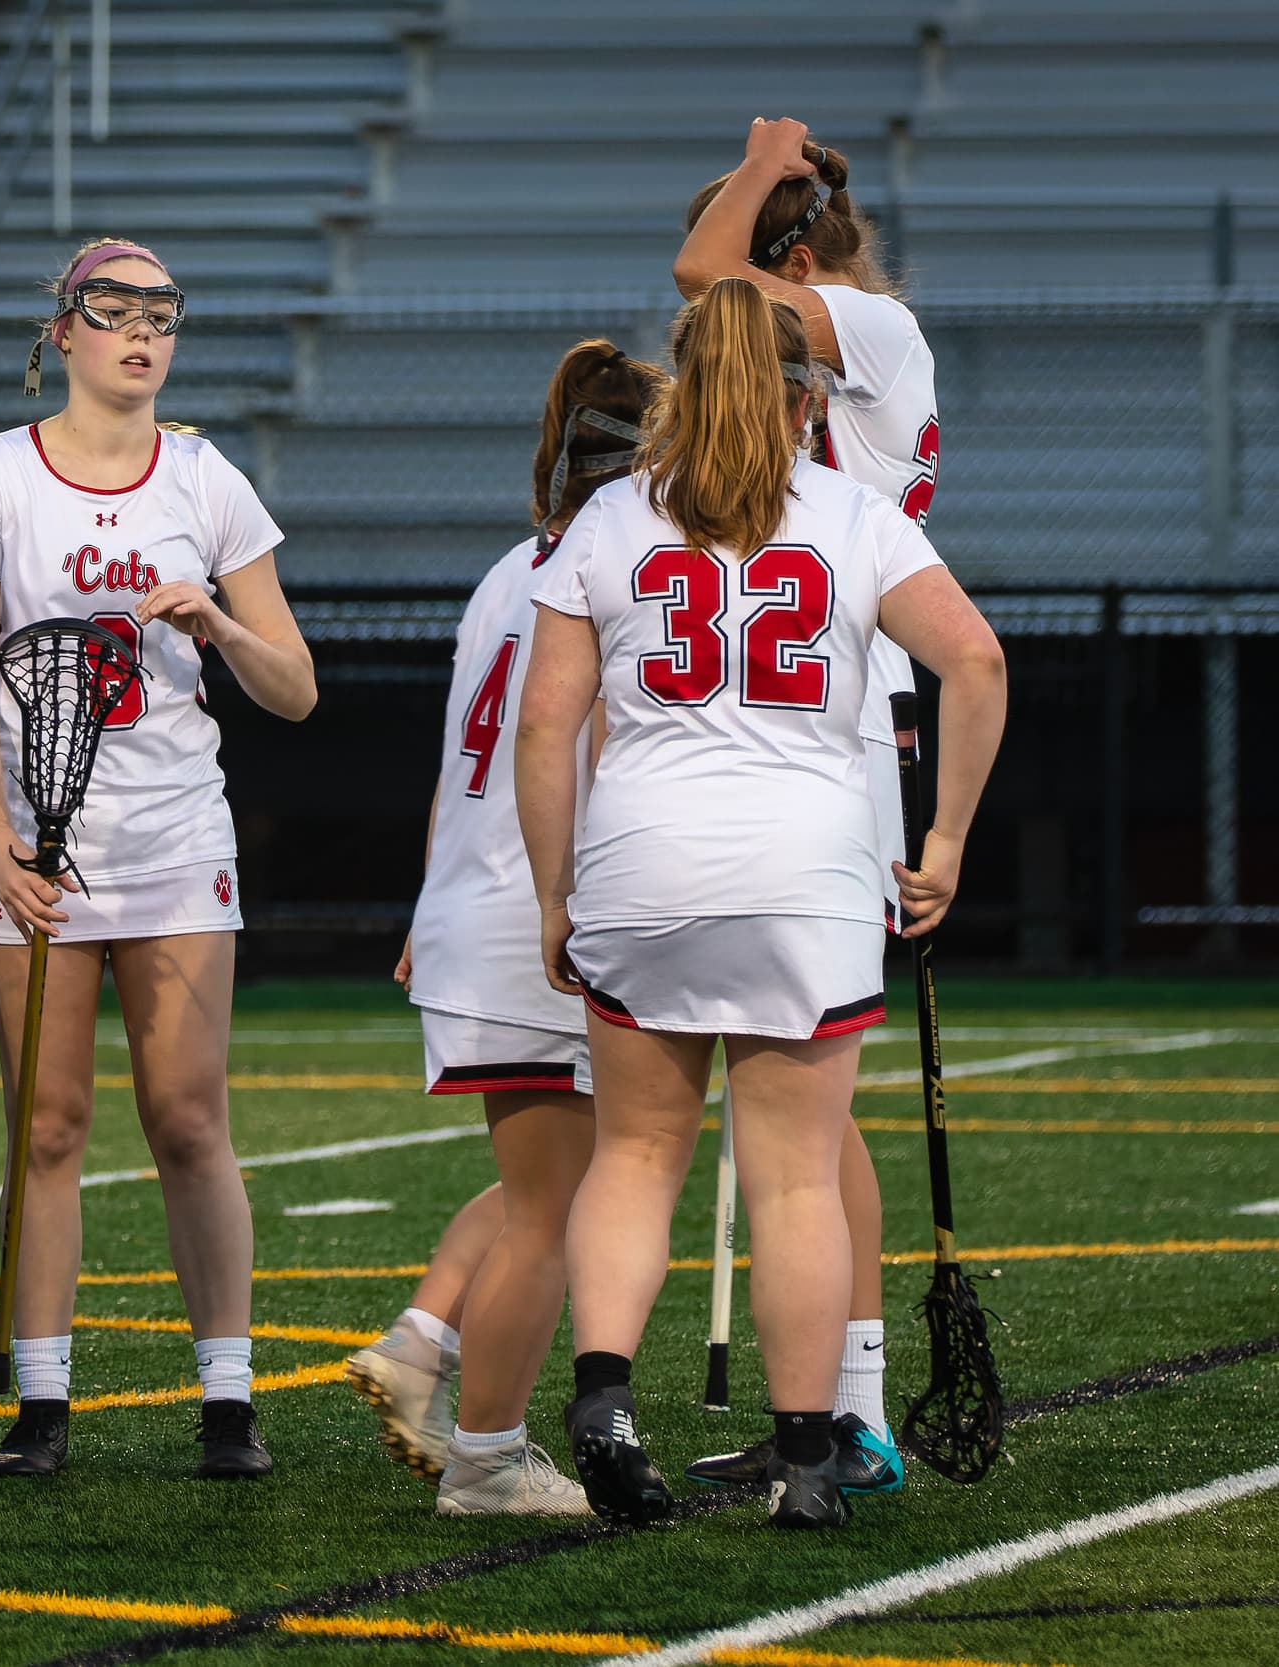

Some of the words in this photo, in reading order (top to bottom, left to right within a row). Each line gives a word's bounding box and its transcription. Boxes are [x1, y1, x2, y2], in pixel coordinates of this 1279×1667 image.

[768, 224, 803, 259] STX
[62, 544, 161, 597] 'Cats
[631, 543, 835, 713] 32
[460, 633, 521, 800] 4
[929, 1074, 946, 1130] STX
